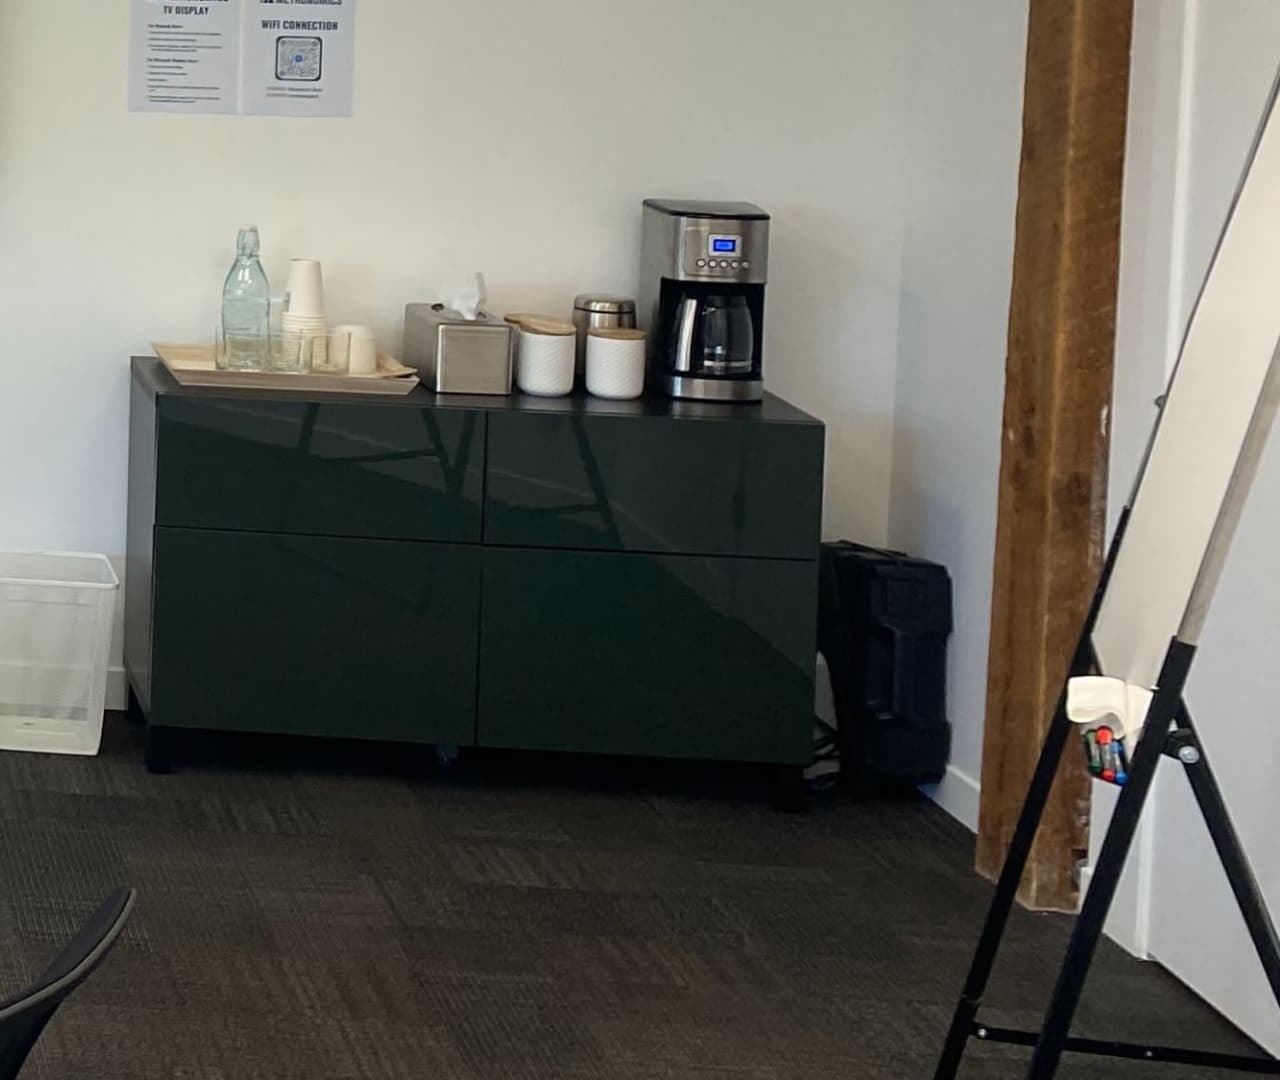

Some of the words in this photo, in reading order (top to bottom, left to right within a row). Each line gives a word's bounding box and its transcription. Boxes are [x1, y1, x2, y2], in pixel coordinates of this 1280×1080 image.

[163, 5, 173, 15] TV
[175, 6, 209, 15] DISPLAY
[261, 19, 280, 30] WIFI
[282, 20, 338, 31] CONNECTION
